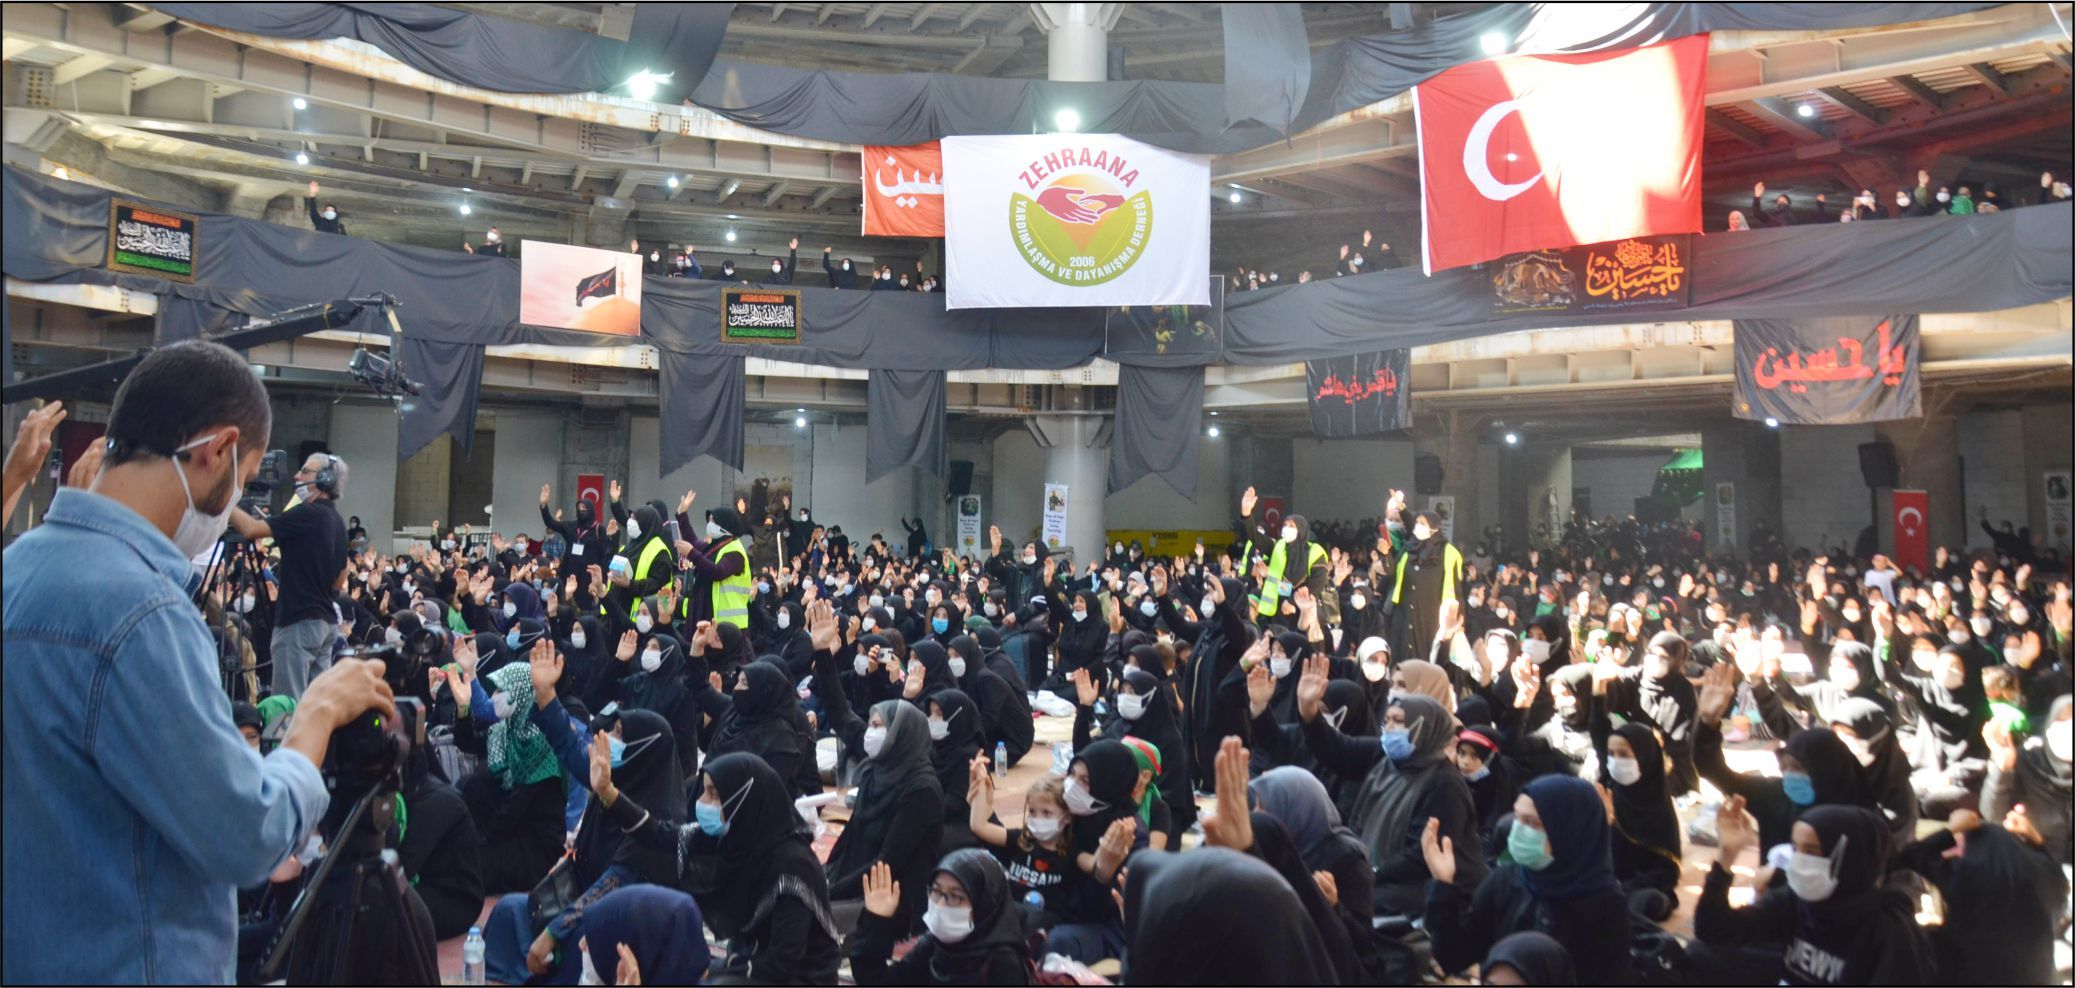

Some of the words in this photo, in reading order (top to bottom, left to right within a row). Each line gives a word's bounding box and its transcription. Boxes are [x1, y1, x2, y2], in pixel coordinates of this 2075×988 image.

[1018, 146, 1140, 191] ZEHRAANA
[1015, 200, 1056, 274] YARDIMLAŞMA
[1058, 266, 1072, 280] VE
[1075, 245, 1137, 281] DAYANIŞMA
[1130, 196, 1147, 247] DERNEĞİ
[1069, 255, 1095, 268] 2006
[1754, 336, 1874, 394] حسين
[1876, 320, 1905, 386] يا
